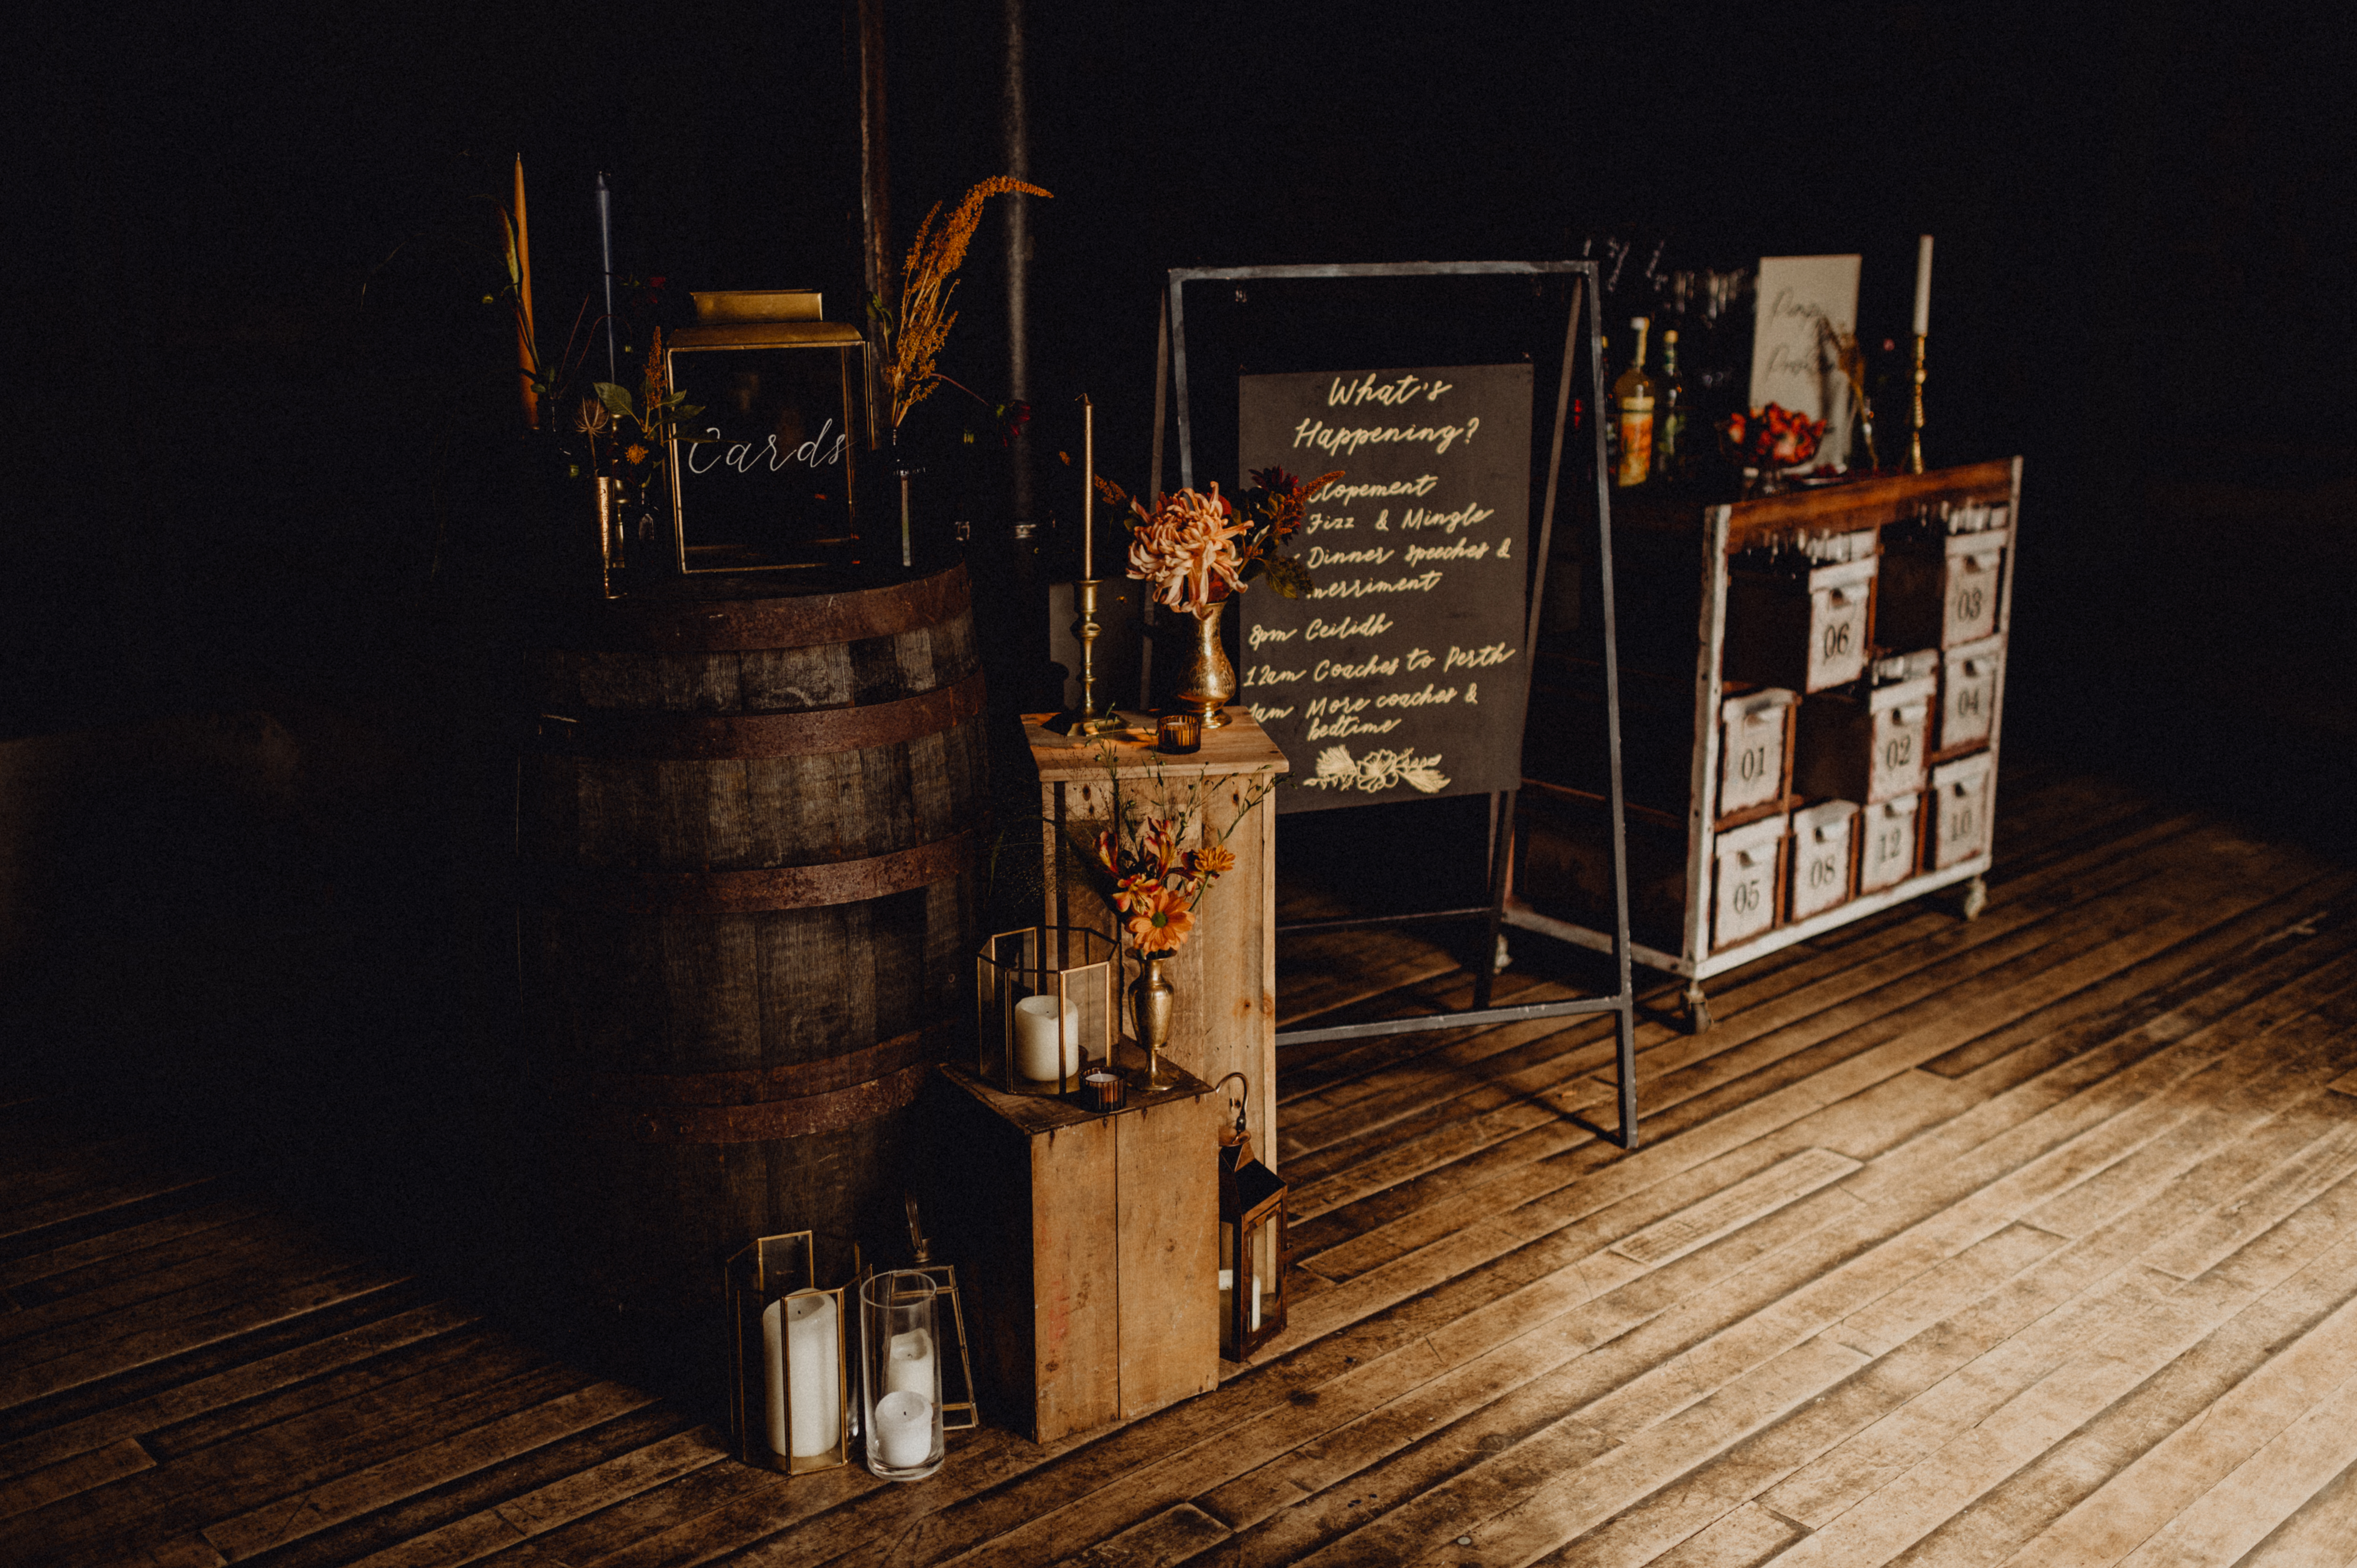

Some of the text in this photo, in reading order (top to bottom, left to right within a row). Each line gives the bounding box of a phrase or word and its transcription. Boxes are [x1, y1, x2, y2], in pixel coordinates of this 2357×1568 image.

[1328, 372, 1452, 406] What's
[688, 418, 857, 474] Cards
[1293, 417, 1480, 457] Happening?
[1307, 474, 1438, 507] lopement
[1306, 501, 1494, 534] Fizz & Mingle
[1306, 545, 1395, 569] Dinner
[1496, 537, 1510, 559] &
[1958, 589, 1981, 621] 03
[1248, 613, 1393, 651] 8pm Ceilidh
[1824, 624, 1849, 657] 06
[1243, 641, 1516, 687] 12am Coaches to Perth
[1305, 696, 1370, 719] More
[1375, 683, 1458, 705] coaches
[1464, 682, 1478, 704] &
[1958, 691, 1980, 716] 04
[1307, 714, 1402, 741] bedtime
[1741, 748, 1765, 781] 01
[1886, 736, 1911, 770] 02
[1951, 810, 1972, 841] 10
[1811, 855, 1836, 888] 08
[1733, 880, 1760, 914] 05
